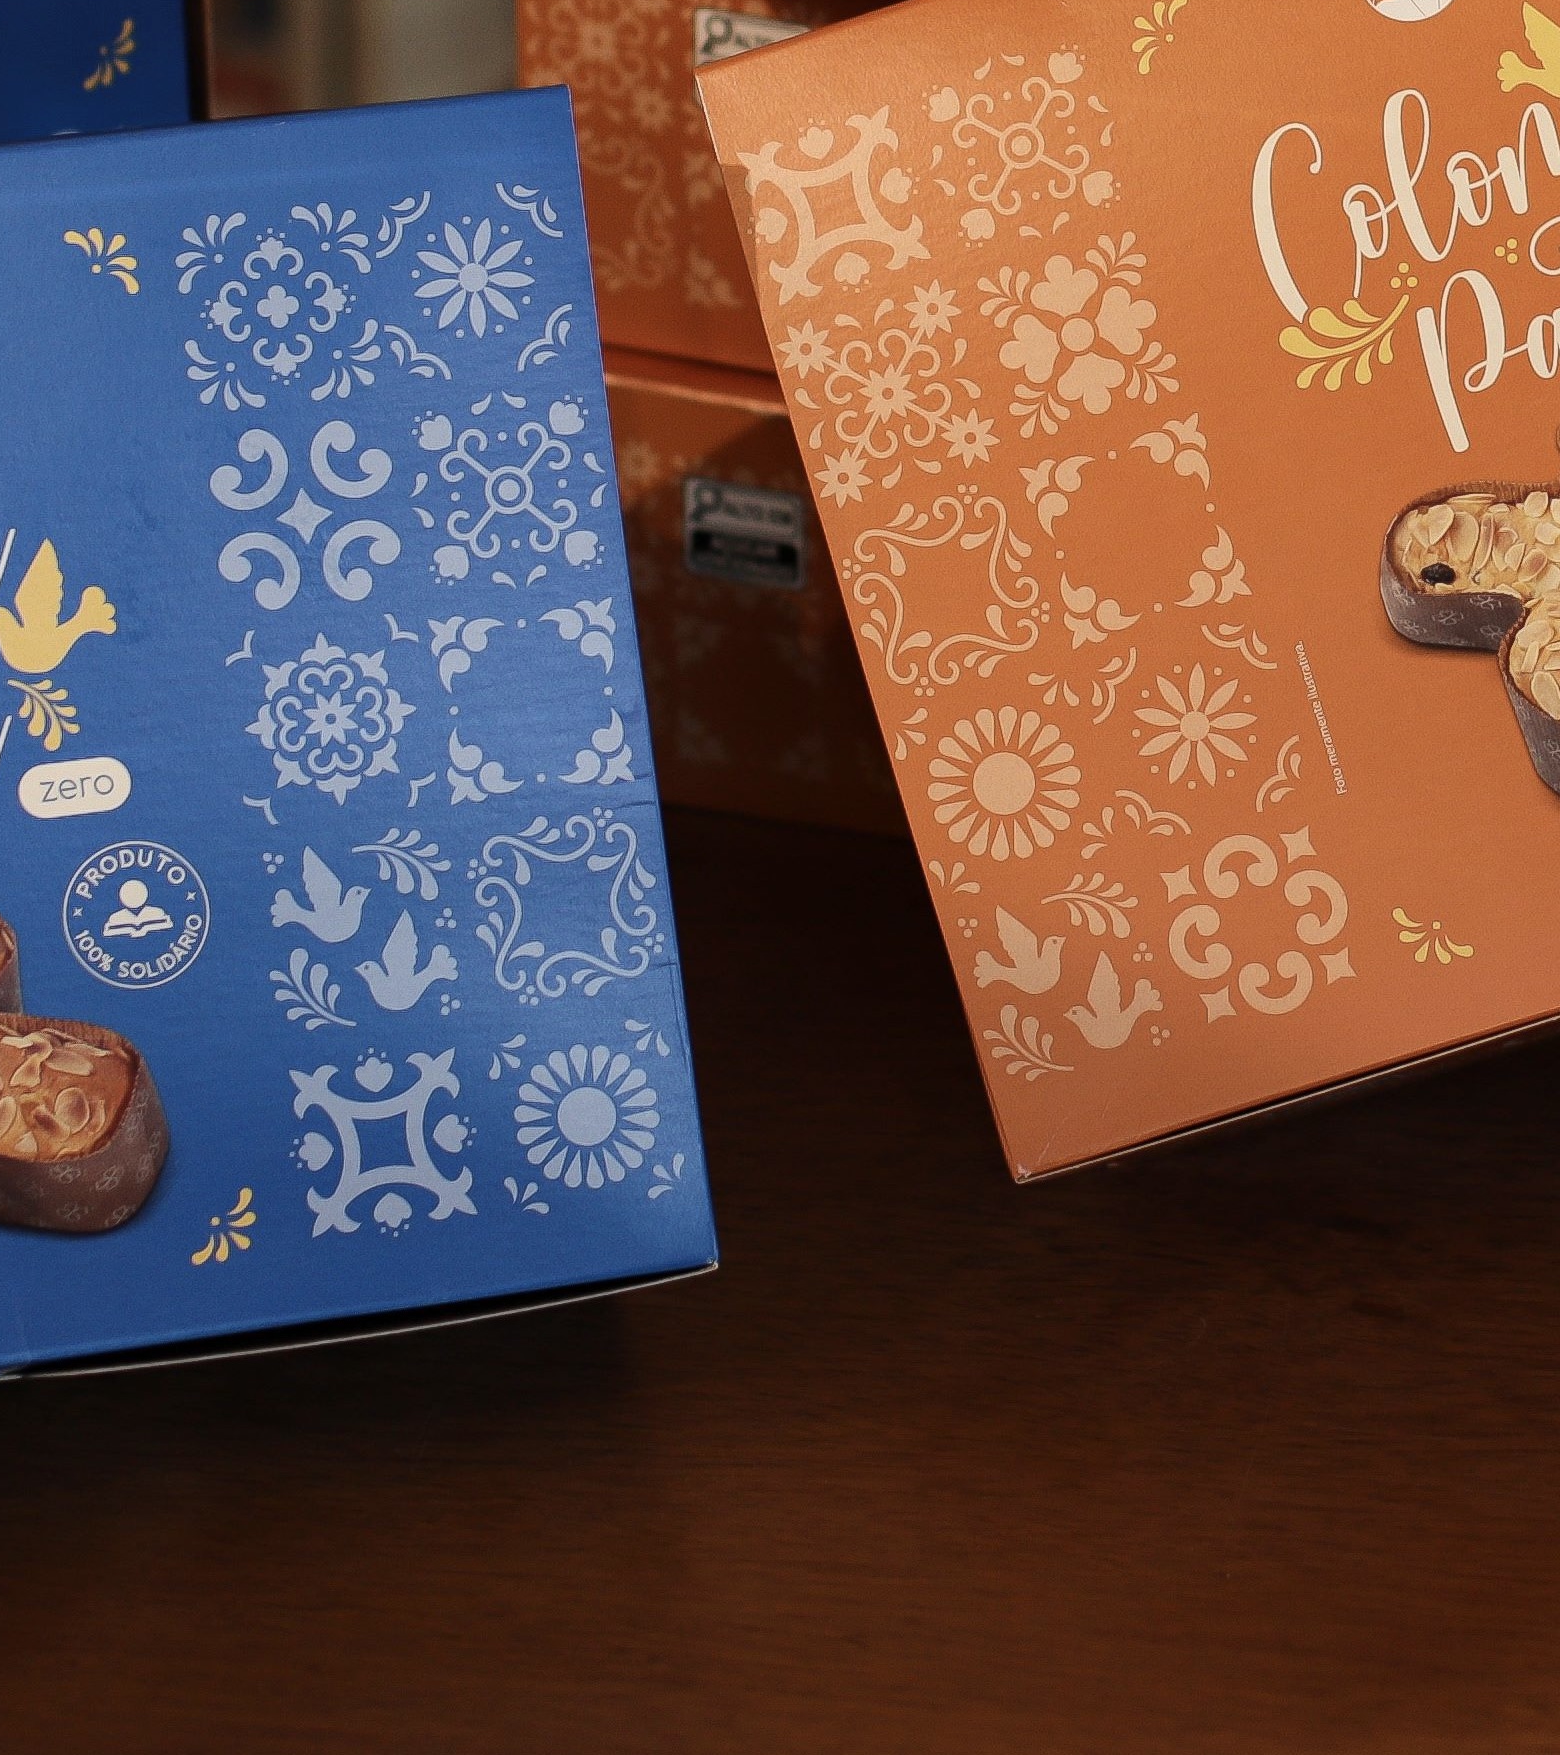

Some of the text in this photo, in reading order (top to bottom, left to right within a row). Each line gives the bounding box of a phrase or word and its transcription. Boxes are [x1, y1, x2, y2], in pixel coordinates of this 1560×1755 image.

[1295, 640, 1347, 796] Foto meramente ilustrativa.
[38, 766, 117, 805] zero
[76, 848, 186, 900] PRODUTO
[74, 913, 203, 980] 100% SOLIDÁRIO
